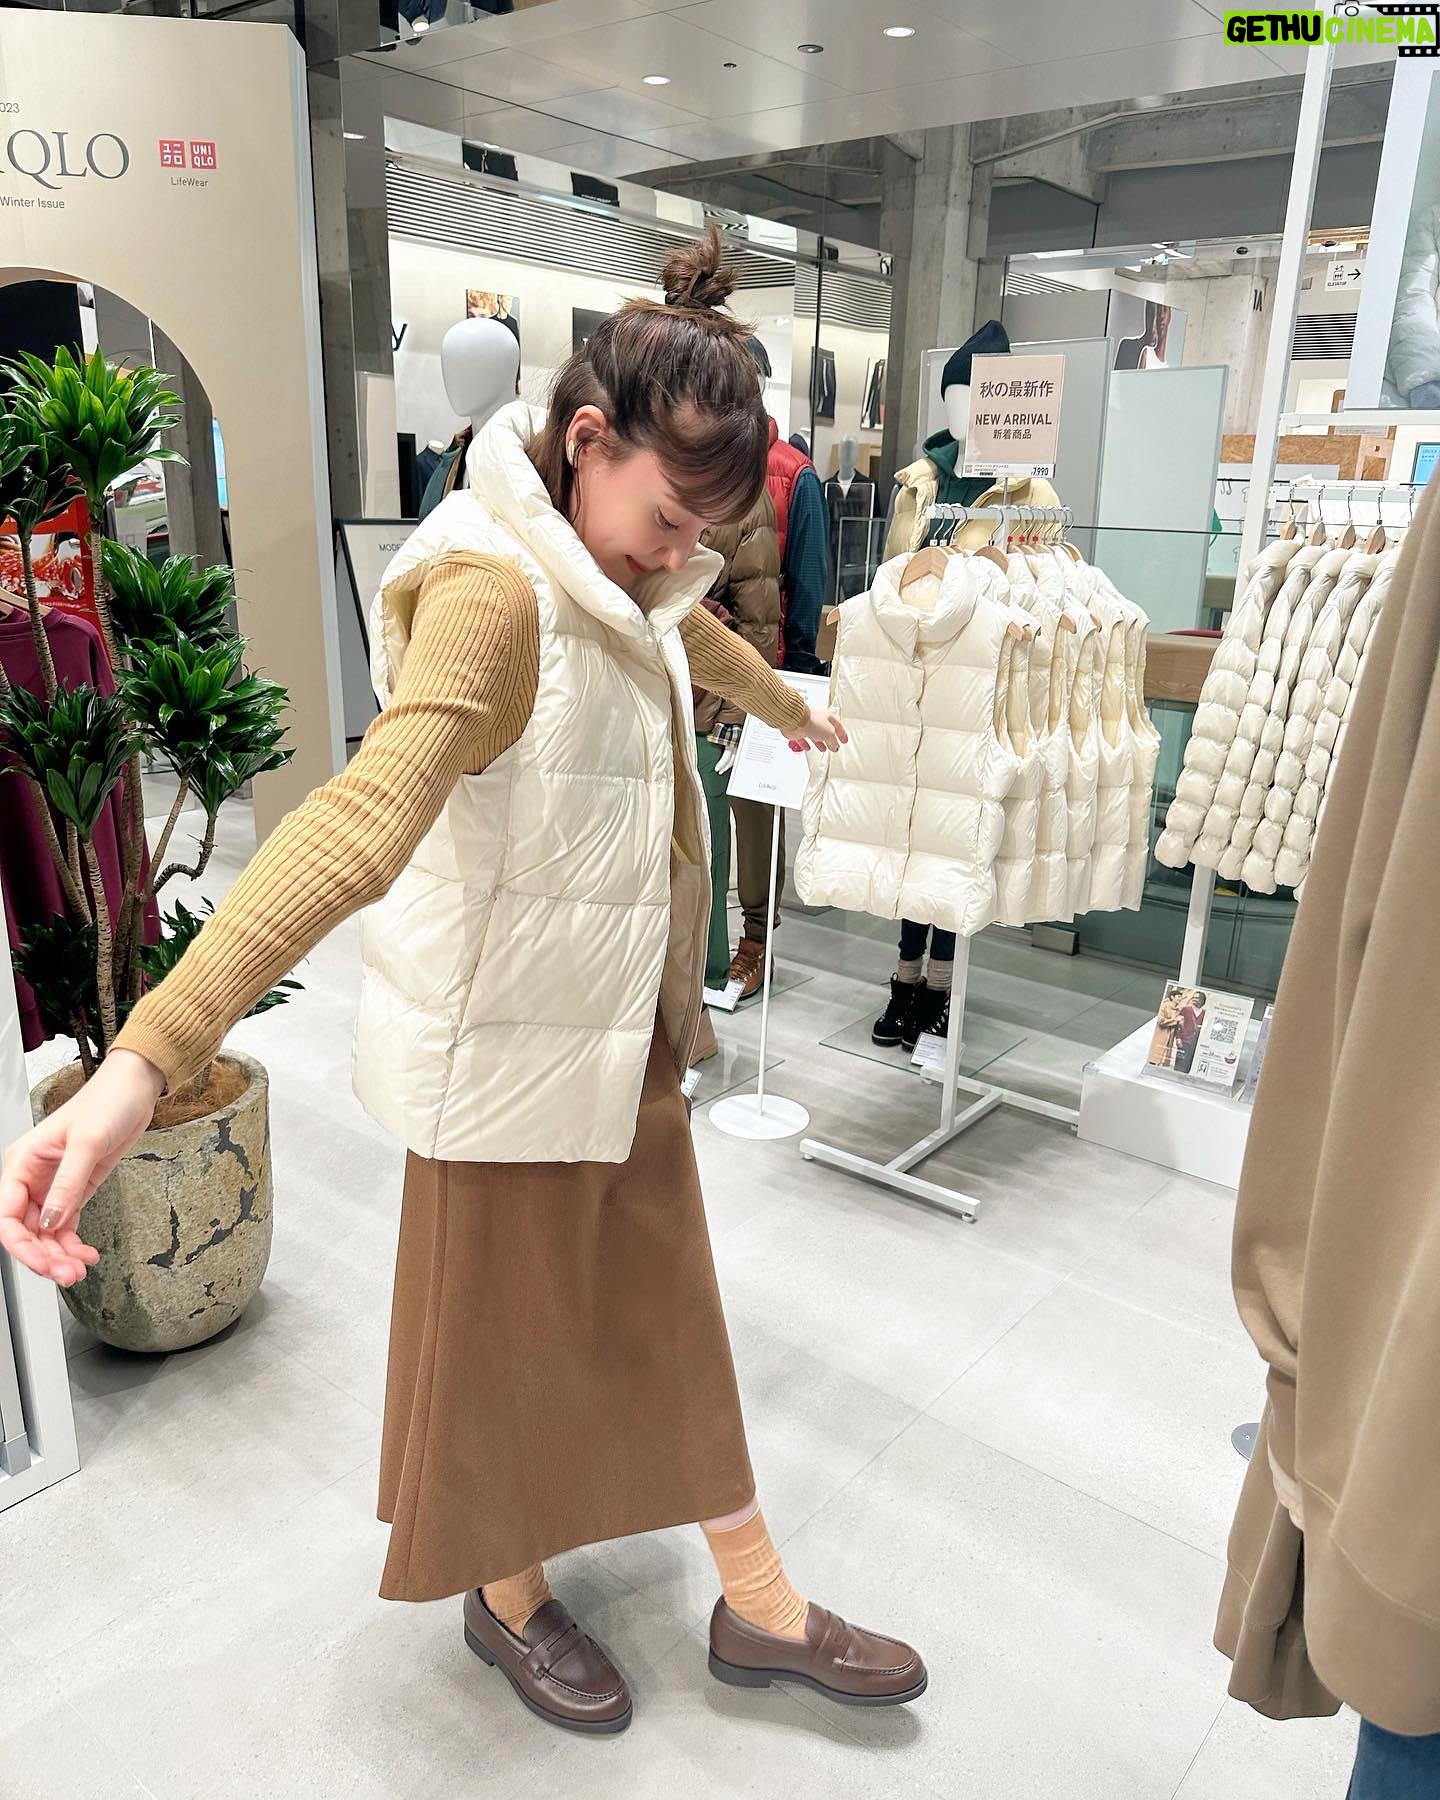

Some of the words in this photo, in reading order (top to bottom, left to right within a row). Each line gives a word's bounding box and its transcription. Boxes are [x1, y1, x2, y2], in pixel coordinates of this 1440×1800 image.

[0, 129, 130, 190] QLO
[170, 176, 209, 187] LifeWear
[37, 197, 65, 208] Issue
[979, 380, 1055, 399] 秋の最新作
[975, 414, 1001, 426] NEW
[1003, 413, 1053, 425] ARRIVAL
[992, 428, 1032, 440] 新着商品
